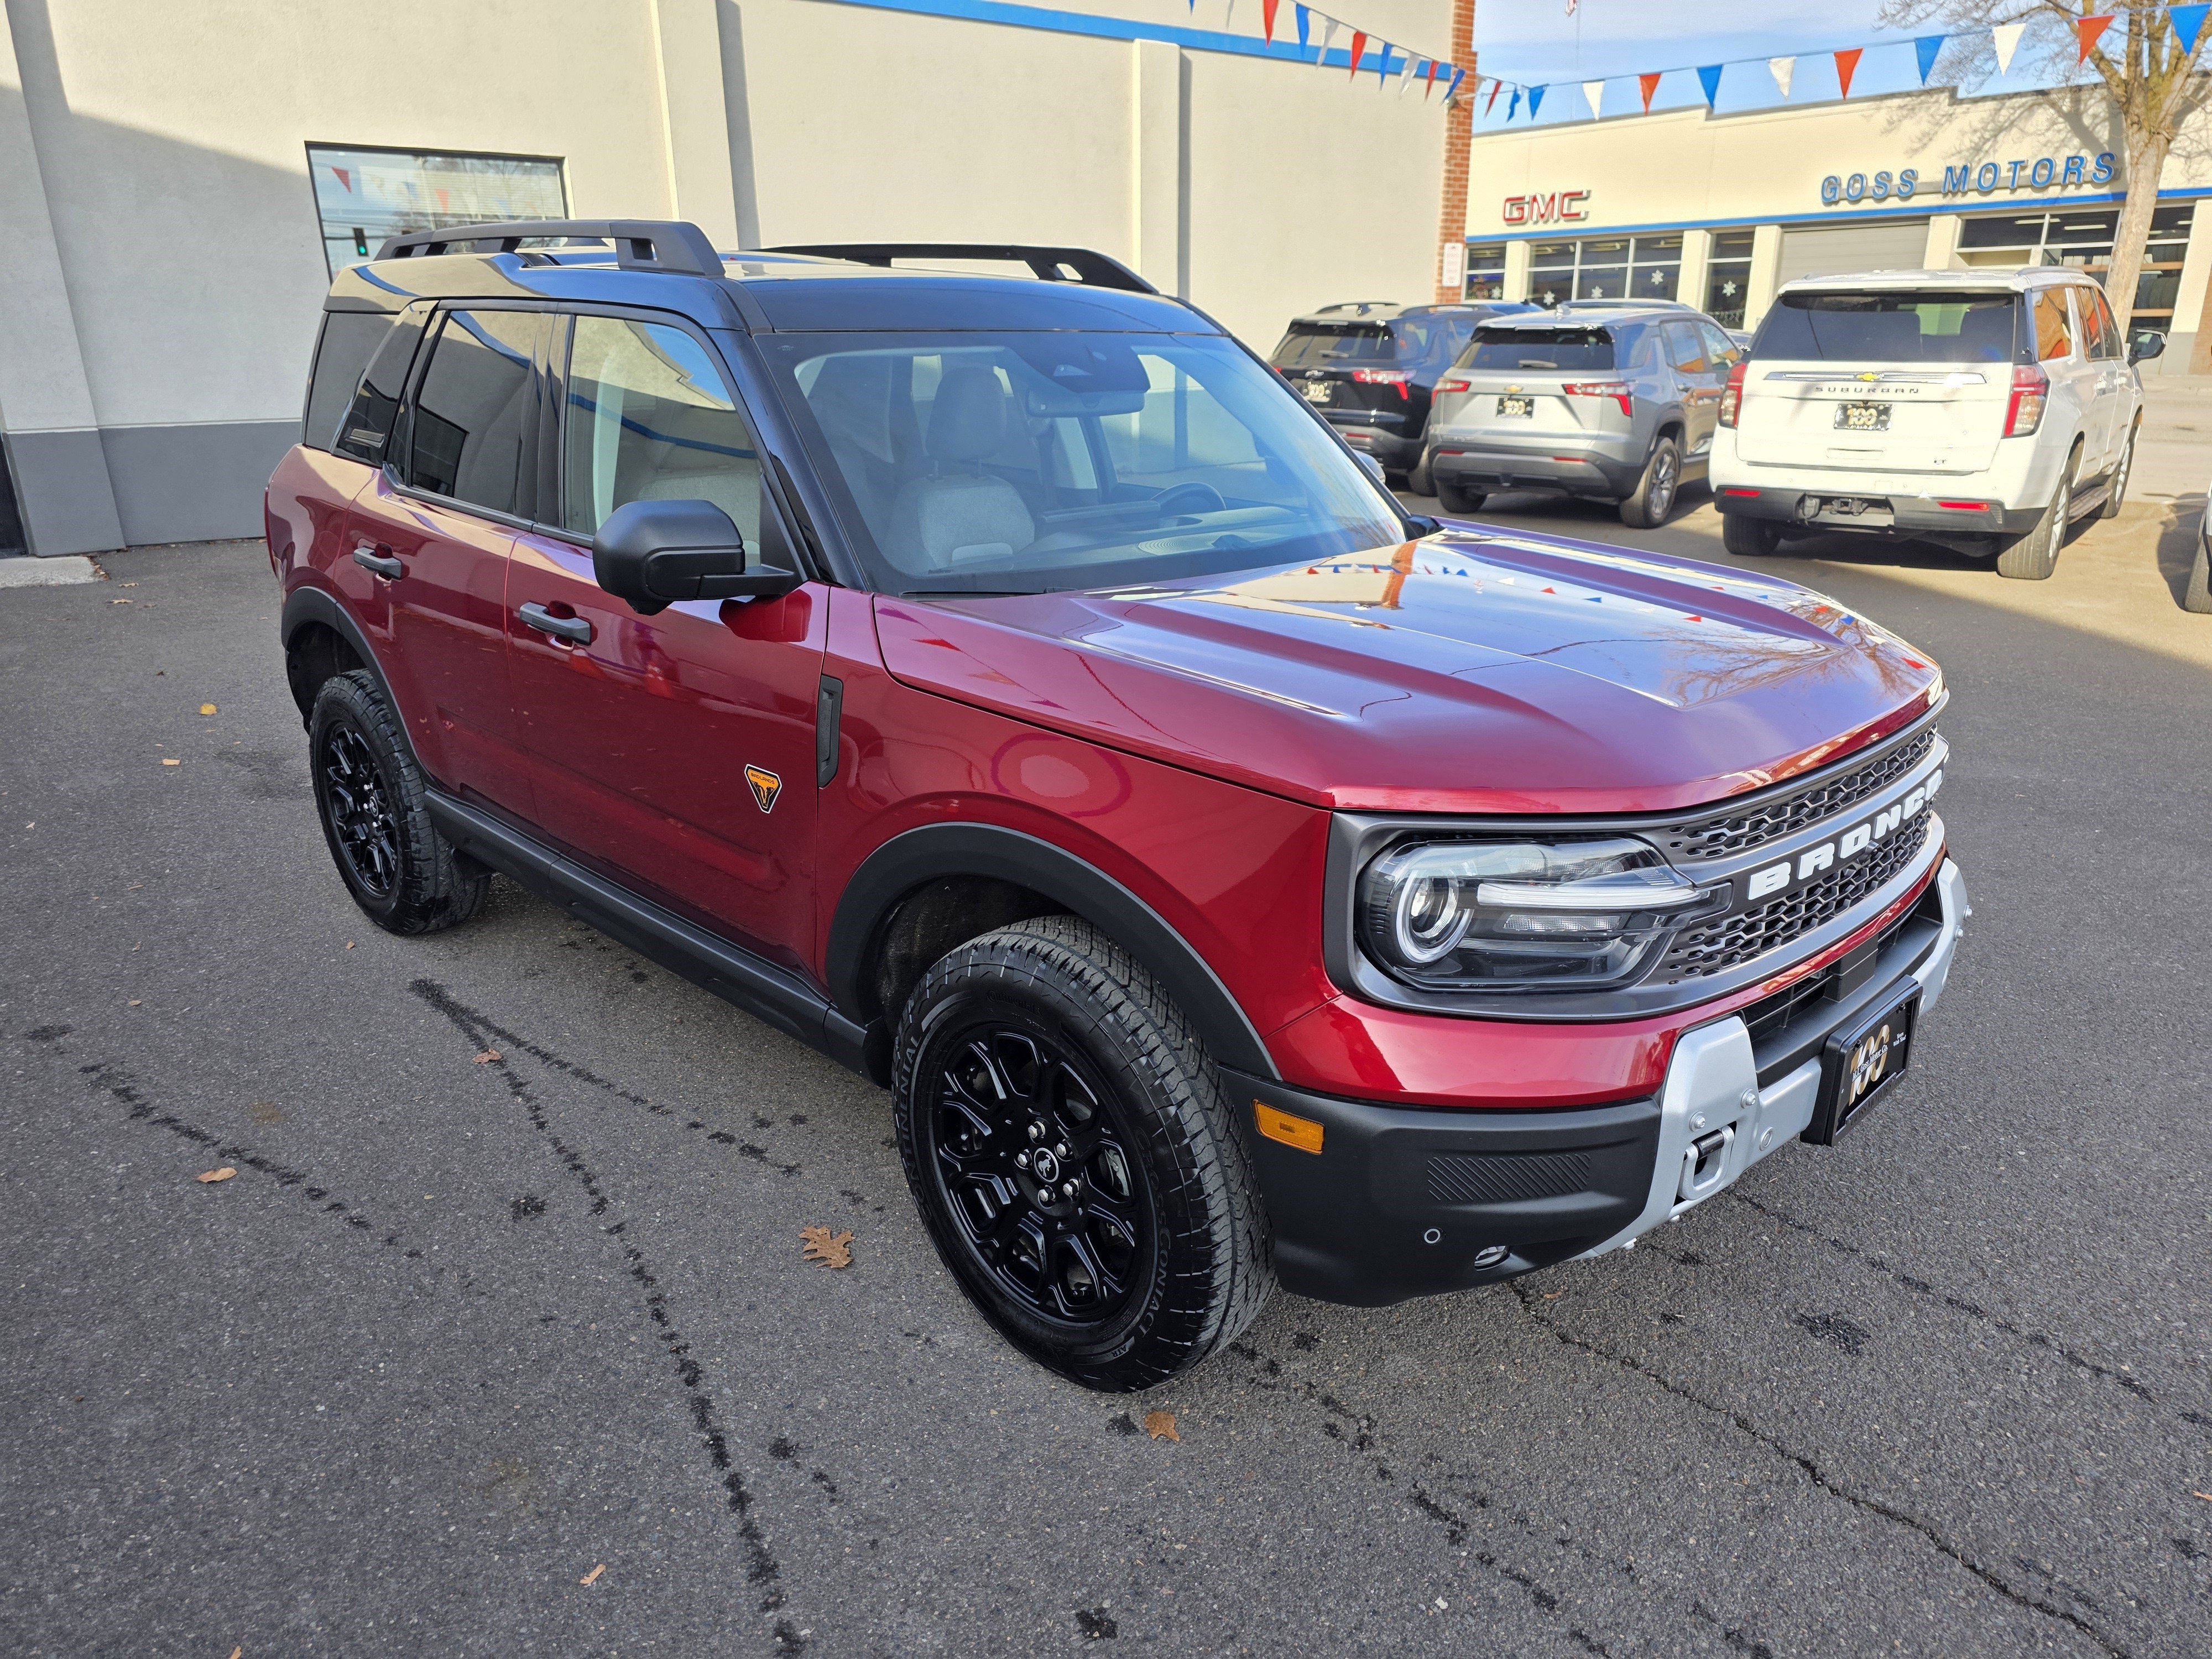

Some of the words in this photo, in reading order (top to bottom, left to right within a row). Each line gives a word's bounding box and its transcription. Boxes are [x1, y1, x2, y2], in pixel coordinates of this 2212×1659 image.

[1821, 168, 1918, 204] GOSS
[1942, 152, 2117, 194] MOTORS
[1503, 190, 1590, 226] GMC
[1847, 408, 1878, 425] 100
[750, 773, 775, 785] BADLANDS
[1747, 769, 1943, 900] BRONCO
[1849, 1024, 1890, 1107] 100
[899, 1036, 932, 1218] CONTINENTAL
[1112, 1344, 1127, 1358] ATR
